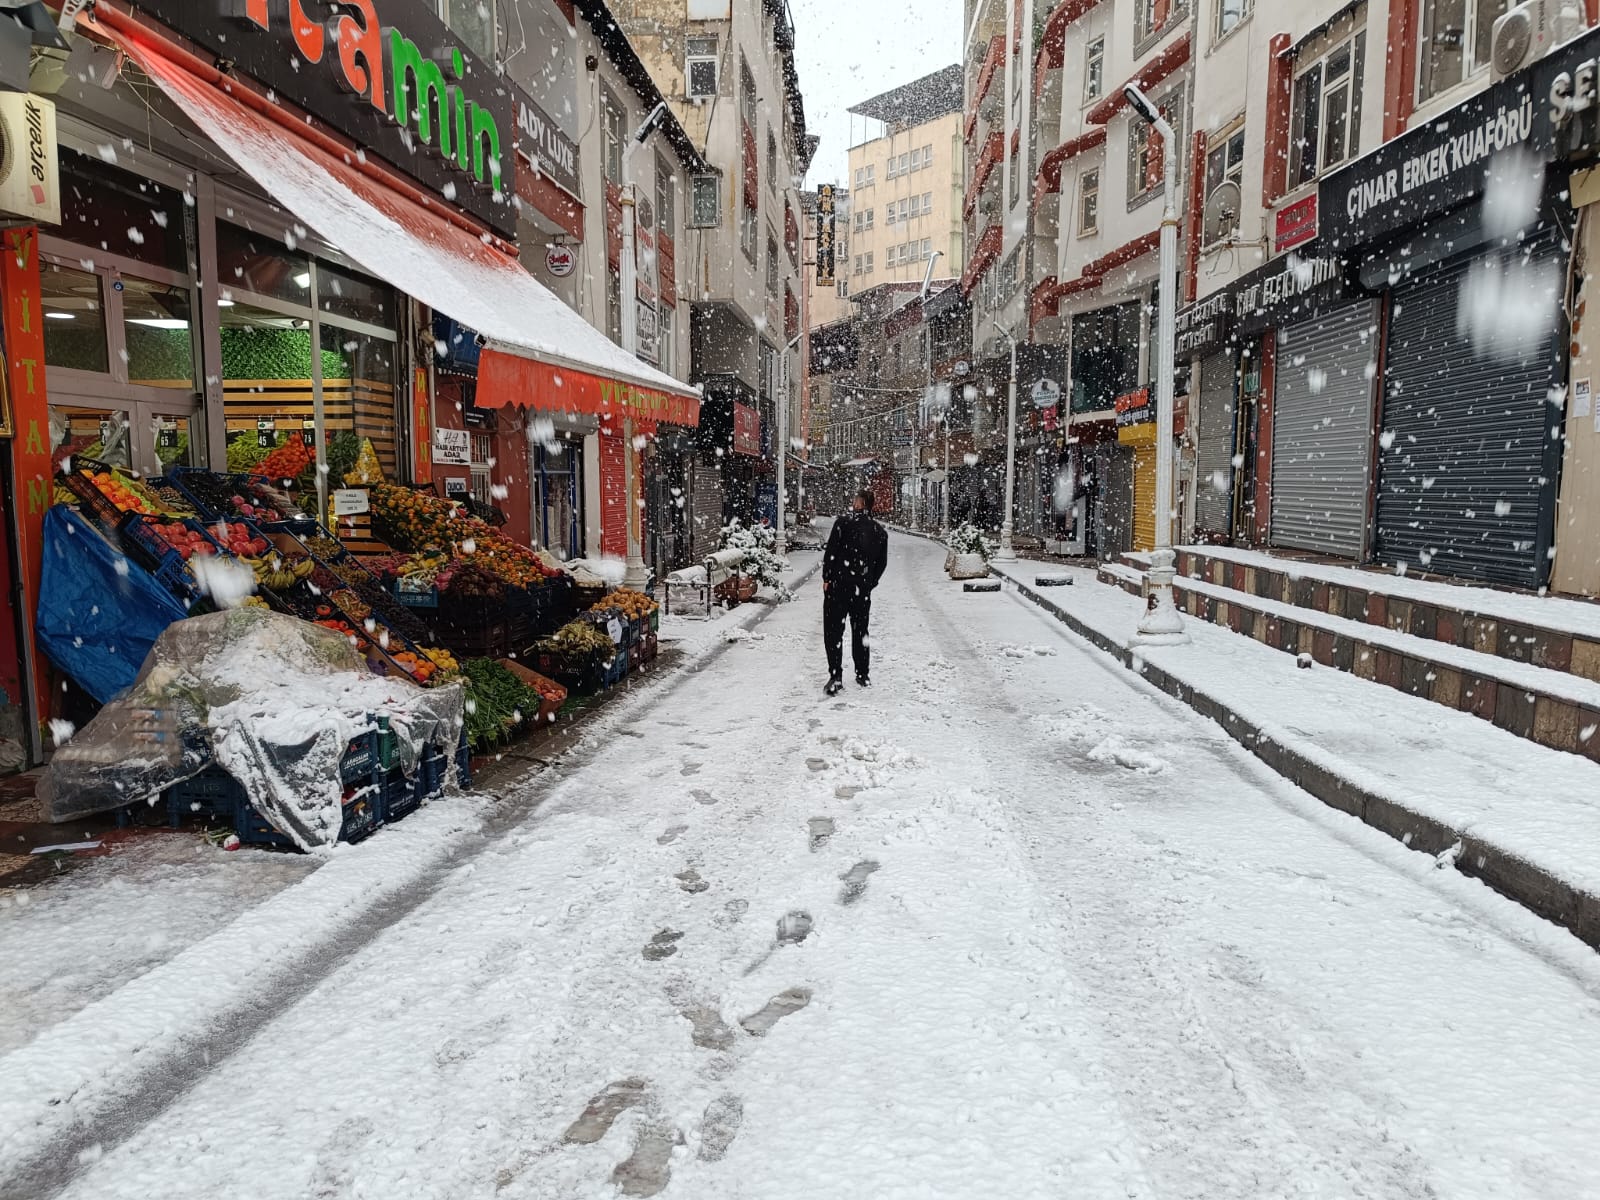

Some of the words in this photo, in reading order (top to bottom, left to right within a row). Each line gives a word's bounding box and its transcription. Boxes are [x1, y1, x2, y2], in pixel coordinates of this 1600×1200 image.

[24, 100, 45, 183] arçelik
[517, 102, 545, 148] ADY
[547, 128, 574, 177] LUXE
[1402, 143, 1449, 194] ERKEK
[1450, 93, 1533, 172] KUAFÖRÜ
[160, 437, 169, 447] 65
[258, 436, 267, 447] 45
[449, 445, 468, 453] ARTIST
